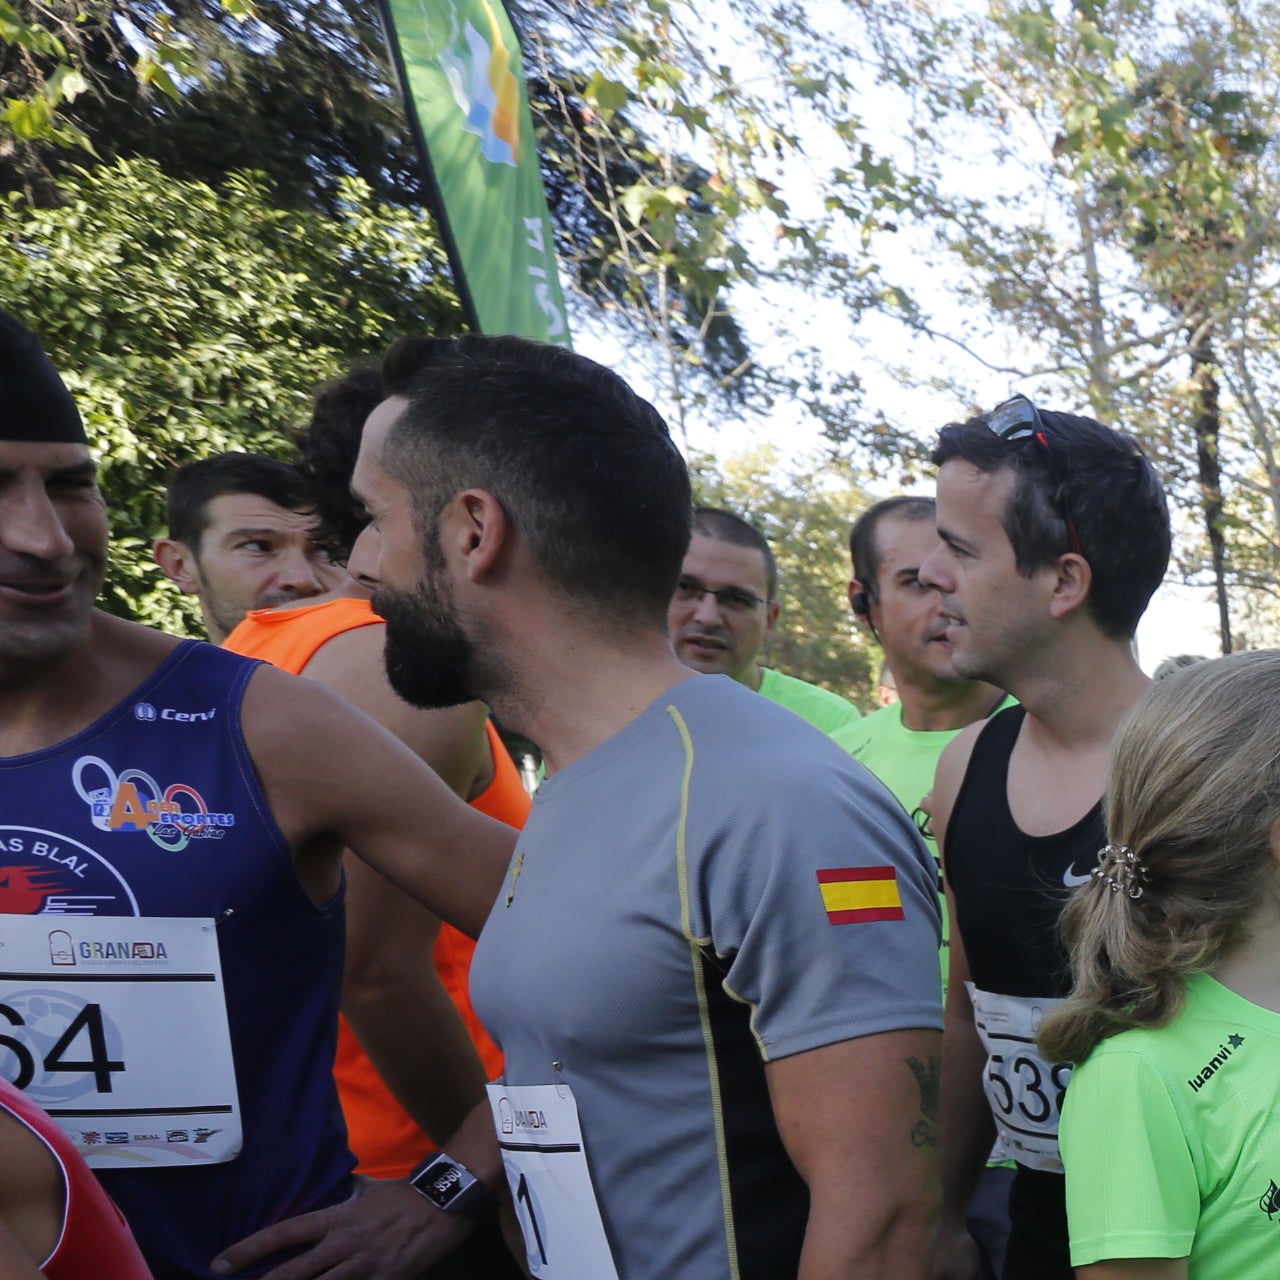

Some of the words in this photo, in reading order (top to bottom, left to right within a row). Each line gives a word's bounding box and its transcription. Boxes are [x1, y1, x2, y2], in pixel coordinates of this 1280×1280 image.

[161, 708, 216, 722] Cervi
[80, 941, 168, 959] GRANADA
[1188, 1044, 1232, 1093] luanvi
[517, 1173, 548, 1266] 1
